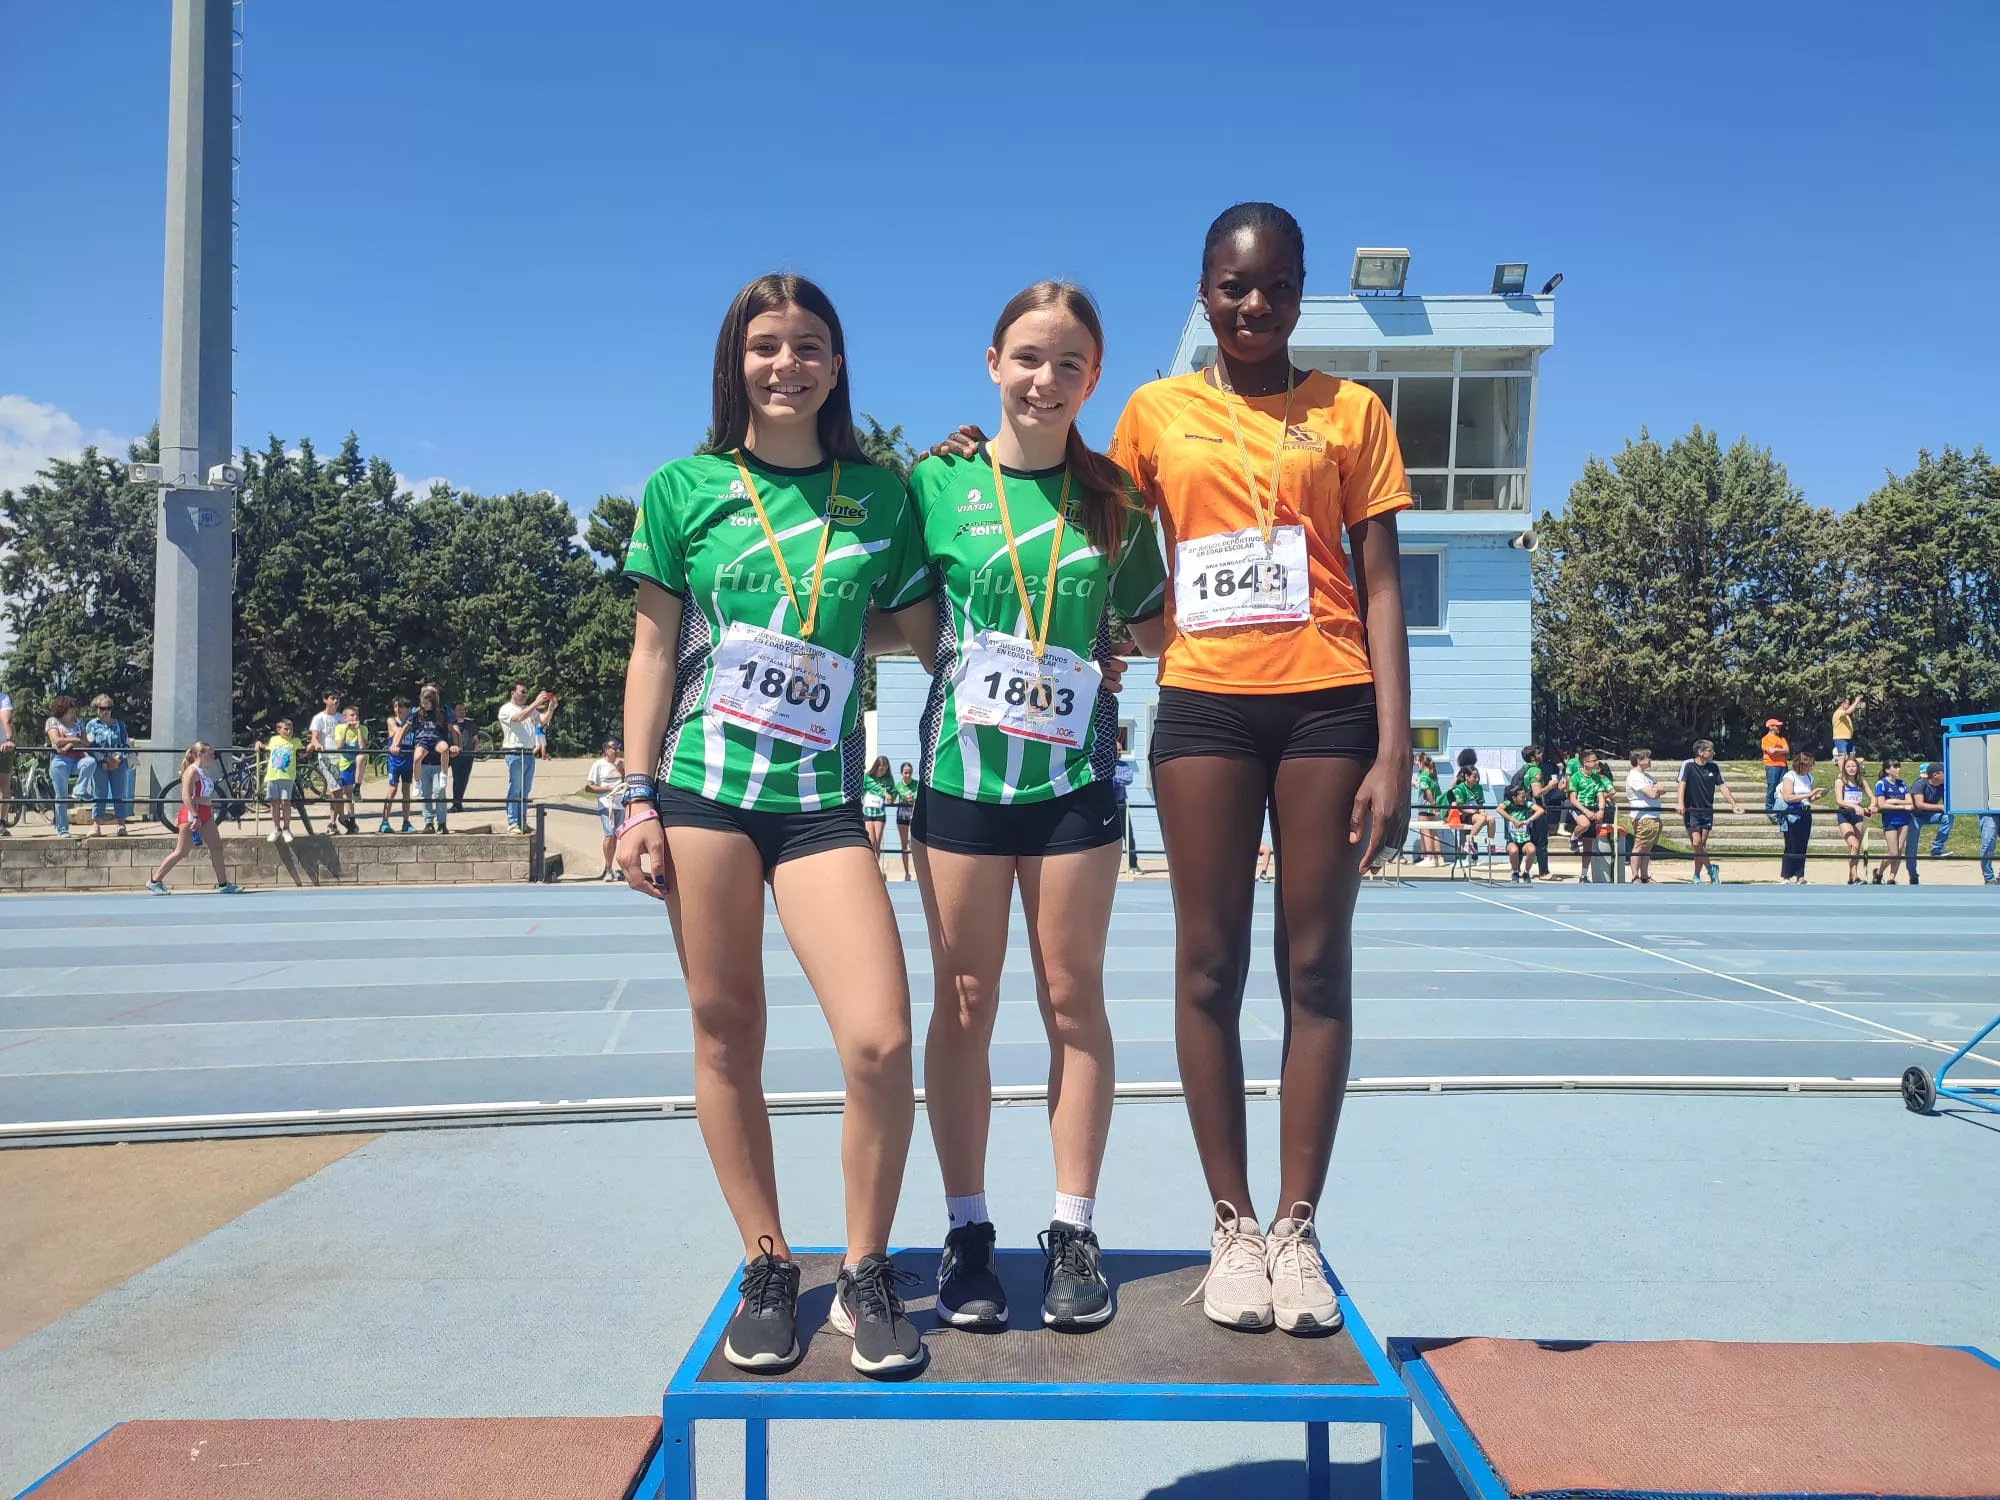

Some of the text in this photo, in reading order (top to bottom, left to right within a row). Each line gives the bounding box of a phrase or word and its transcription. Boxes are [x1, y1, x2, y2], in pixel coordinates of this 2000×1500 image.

[957, 502, 993, 512] VIATOR
[729, 516, 761, 527] ZOIT
[1224, 542, 1255, 553] ESCOLAR
[714, 563, 860, 601] Huesca
[970, 569, 1095, 598] Huesca
[1193, 563, 1287, 600] 1843
[764, 640, 785, 652] EDAD
[784, 639, 827, 659] DEPOTIVOS
[996, 647, 1007, 655] EN
[1007, 650, 1026, 660] EDAD
[999, 641, 1025, 654] JUEGOS
[739, 660, 831, 713] 1800
[984, 671, 1075, 716] 1803
